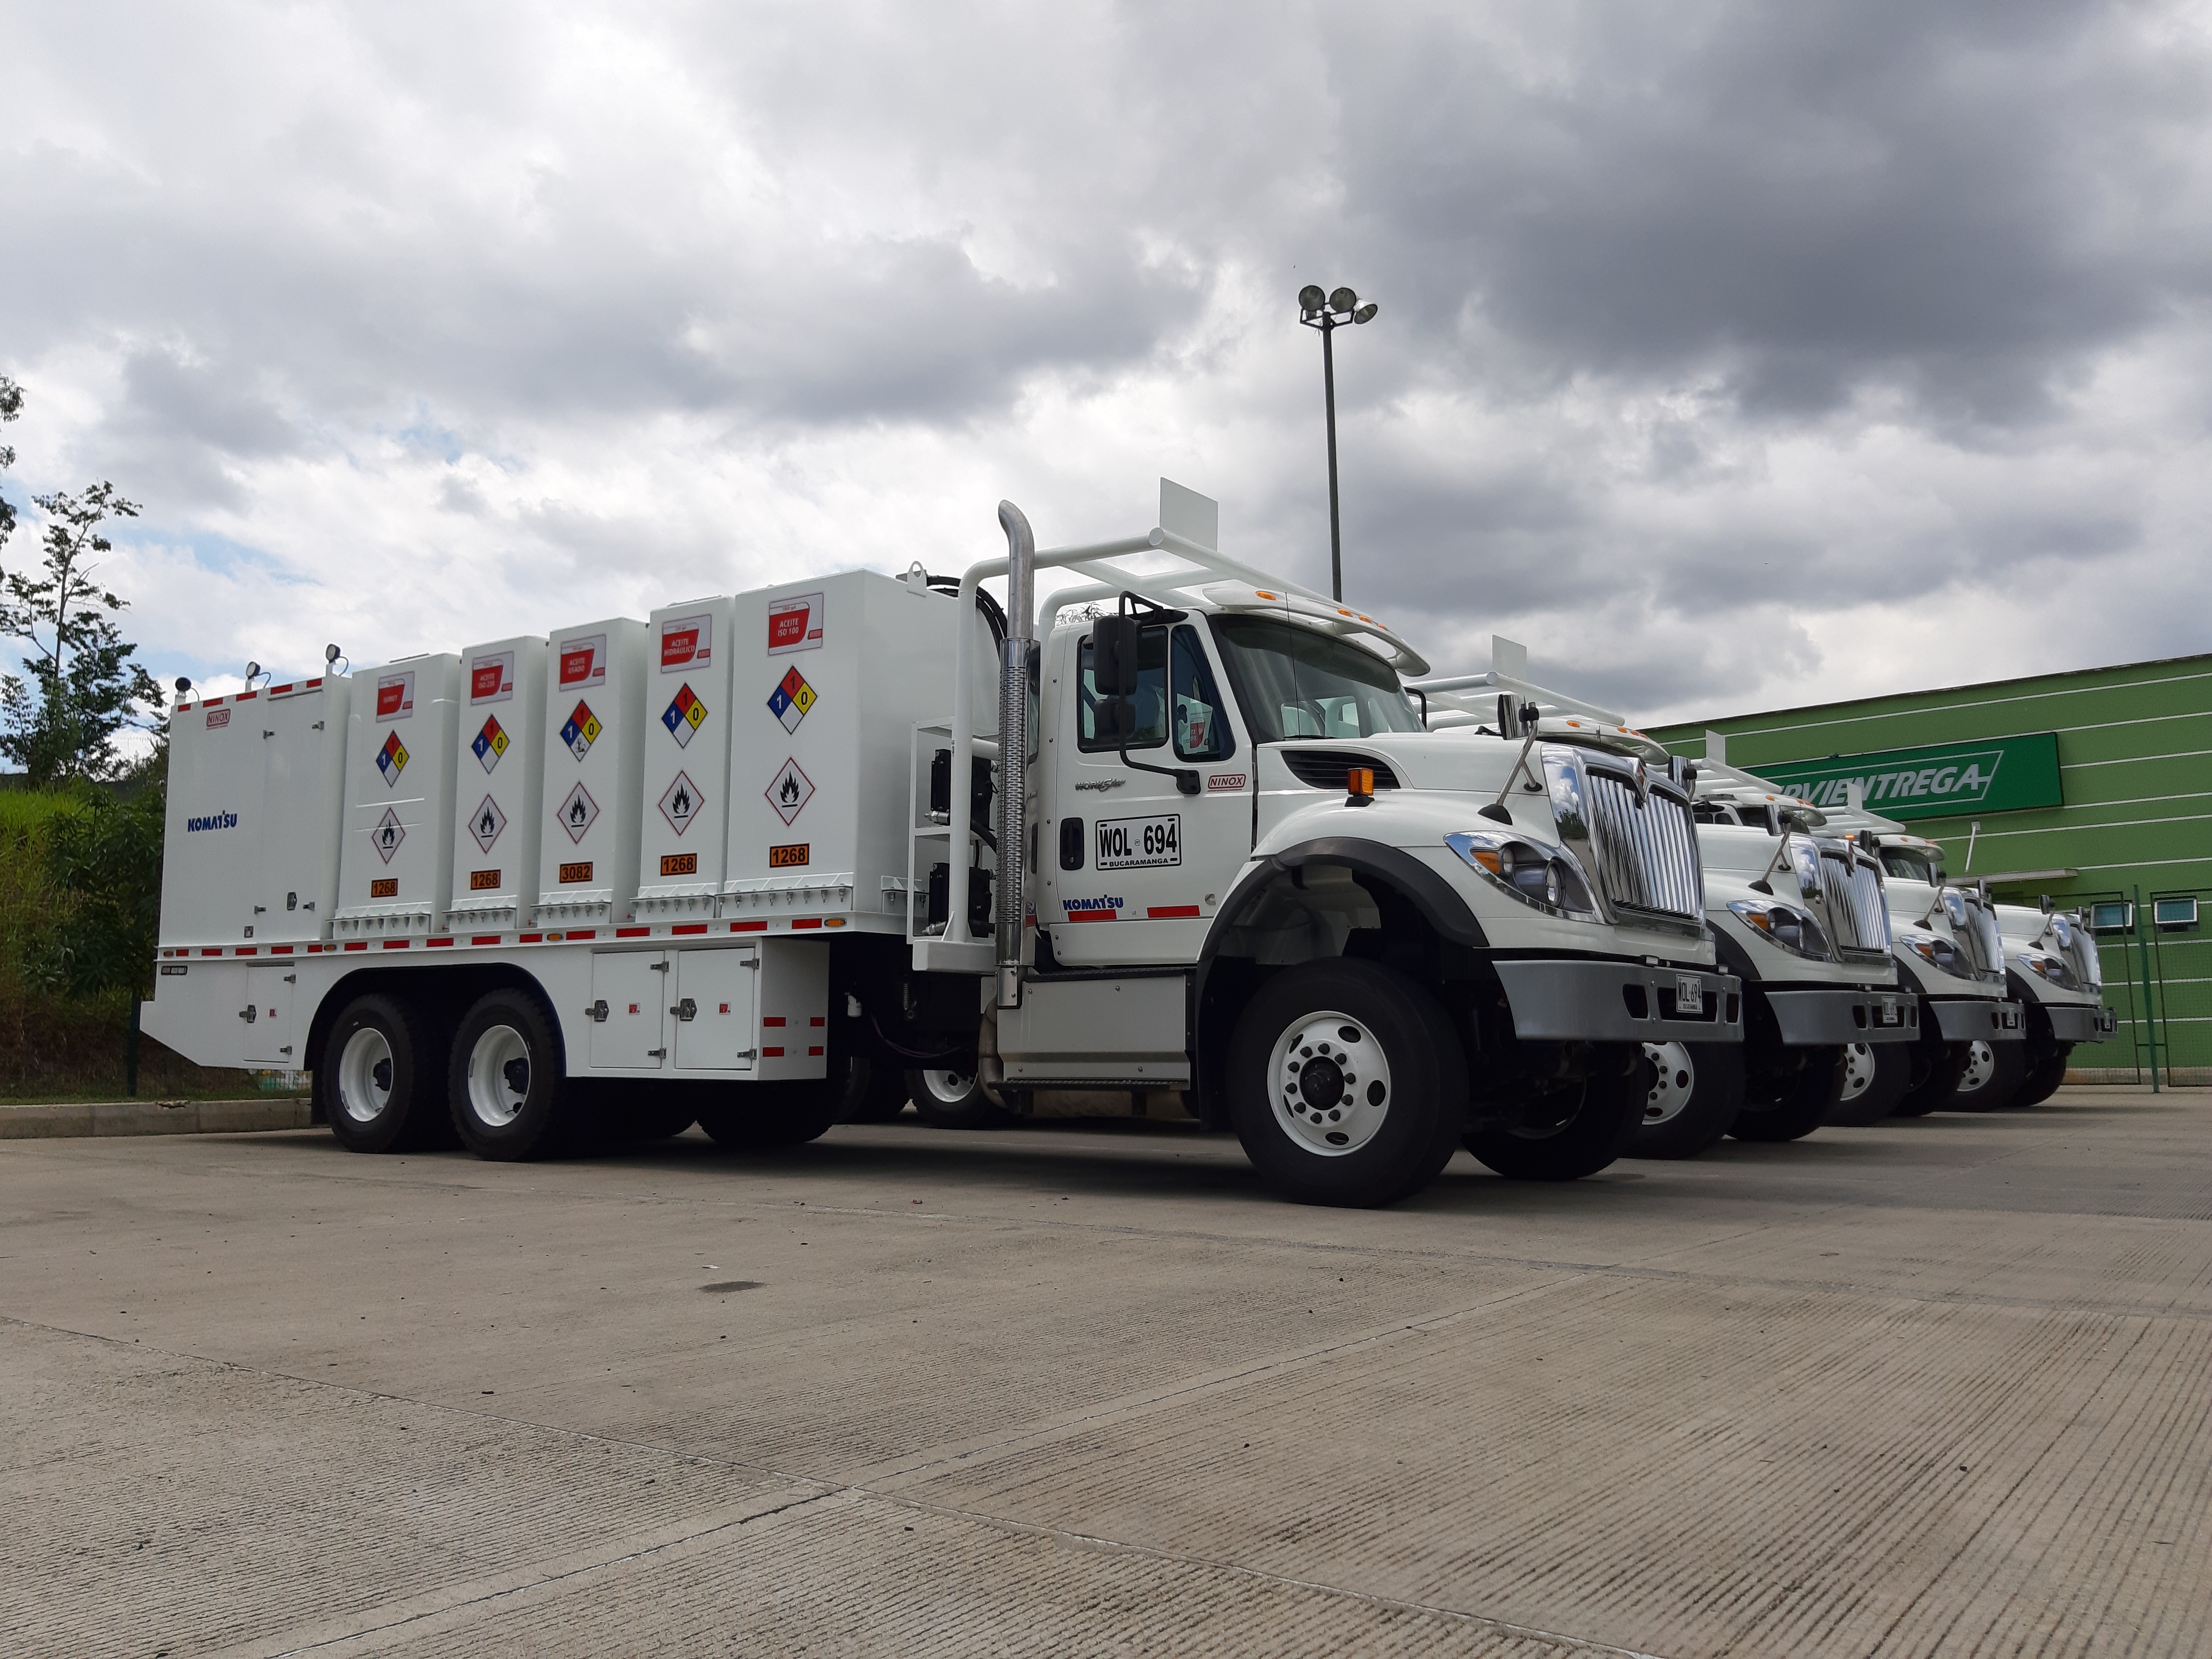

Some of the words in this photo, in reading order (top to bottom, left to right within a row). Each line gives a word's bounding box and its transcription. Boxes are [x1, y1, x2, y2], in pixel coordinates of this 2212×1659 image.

[780, 618, 799, 628] ACEITE
[672, 638, 689, 647] ACEITE
[664, 645, 695, 656] HIDRAULICO
[790, 676, 795, 689] 1
[777, 694, 782, 710] 1
[801, 692, 808, 705] 0
[209, 712, 228, 724] NINOX
[670, 710, 676, 724] 1
[693, 708, 699, 721] 0
[568, 726, 573, 739] 1
[589, 723, 594, 735] 0
[479, 739, 483, 751] 1
[498, 737, 503, 749] 0
[382, 753, 386, 765] 1
[398, 752, 403, 763] 0
[1210, 776, 1243, 787] NINOX
[188, 810, 237, 833] KOMATSU
[1099, 827, 1132, 858] WOL
[1144, 823, 1177, 855] 694
[773, 847, 806, 864] 1268
[1109, 858, 1168, 867] BUCARAMANGA
[664, 857, 694, 872] 1268
[562, 865, 590, 879] 3082
[473, 873, 498, 887] 1268
[374, 881, 396, 894] 1268
[1063, 894, 1124, 910] KOMATSU
[1678, 981, 1689, 1002] WOL
[1691, 983, 1701, 1003] 694
